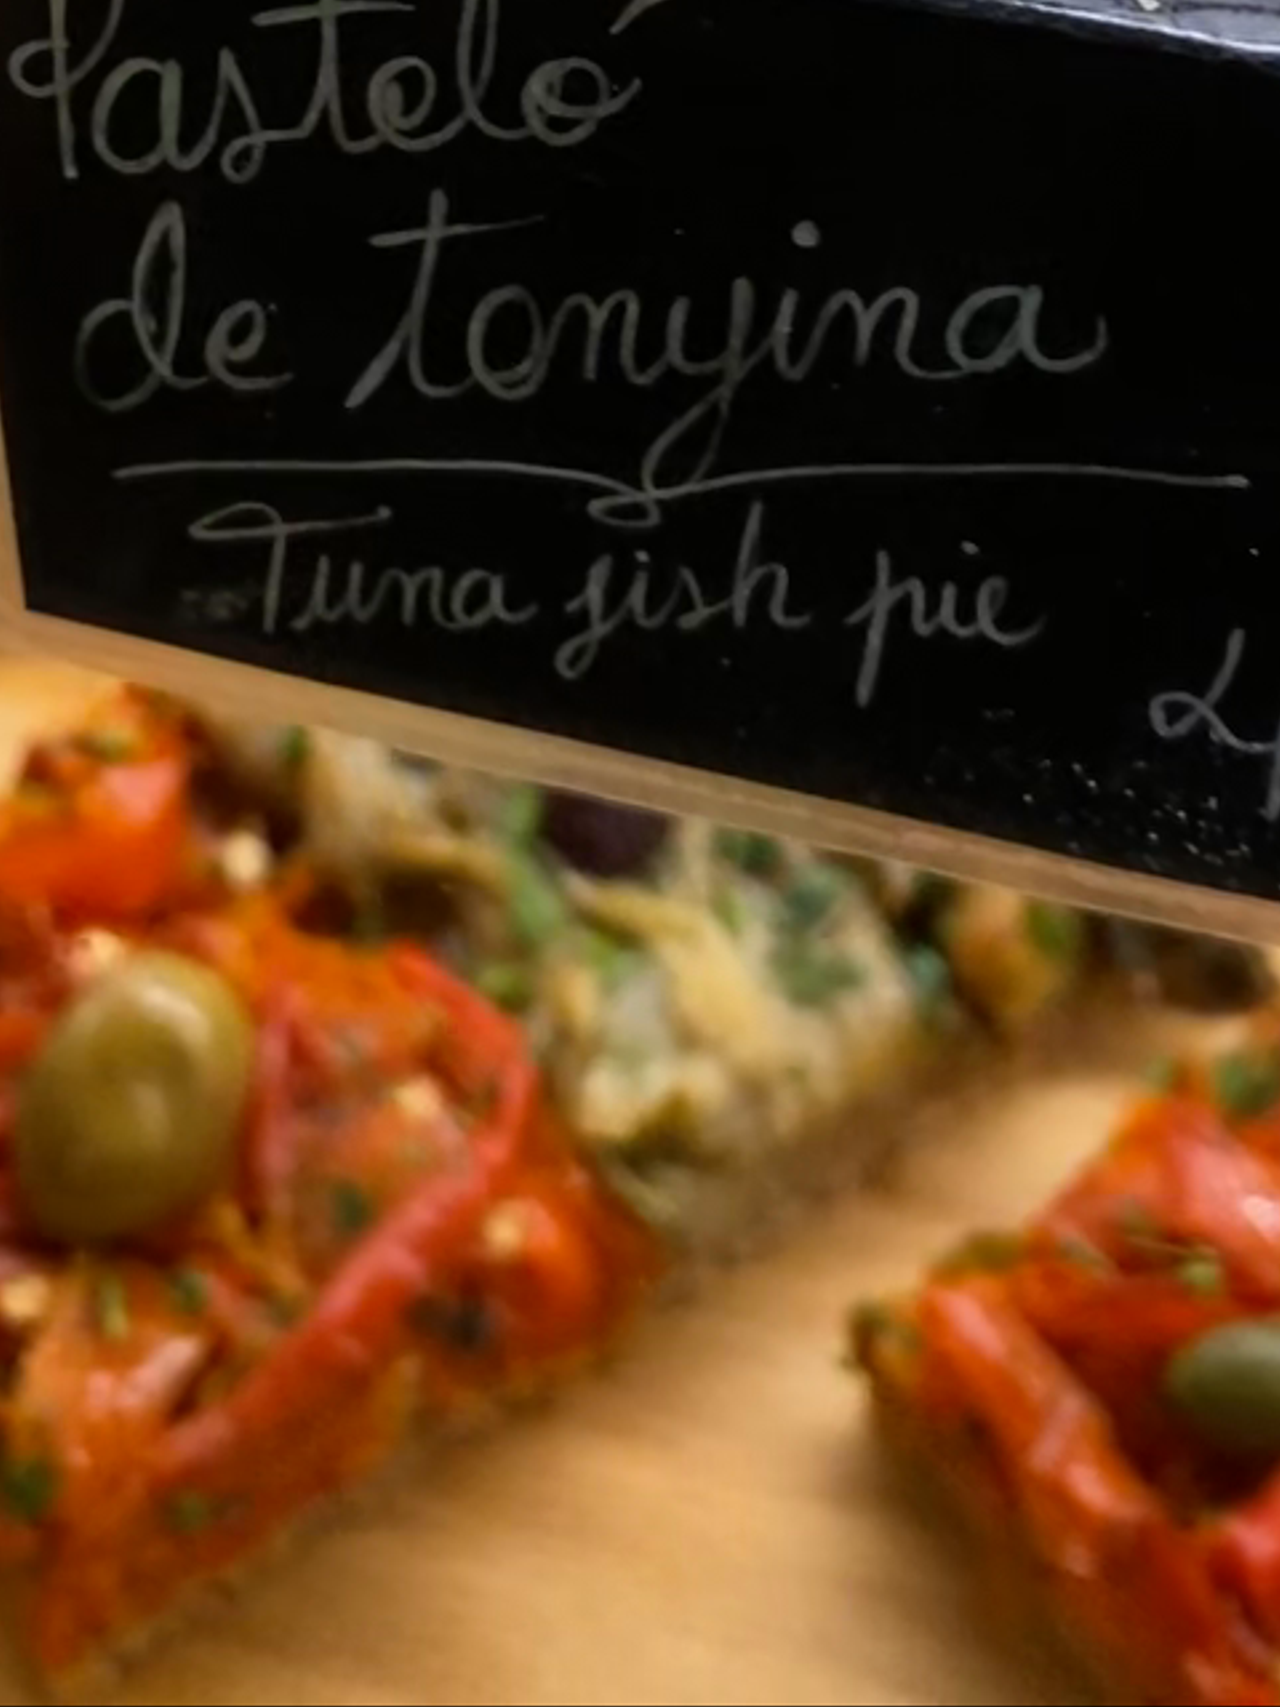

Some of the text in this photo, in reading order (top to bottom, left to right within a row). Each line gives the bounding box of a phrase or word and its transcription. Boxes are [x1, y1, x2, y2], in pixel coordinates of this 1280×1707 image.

[74, 189, 1110, 502] de tonyina
[188, 499, 1046, 709] Tuna fish pie
